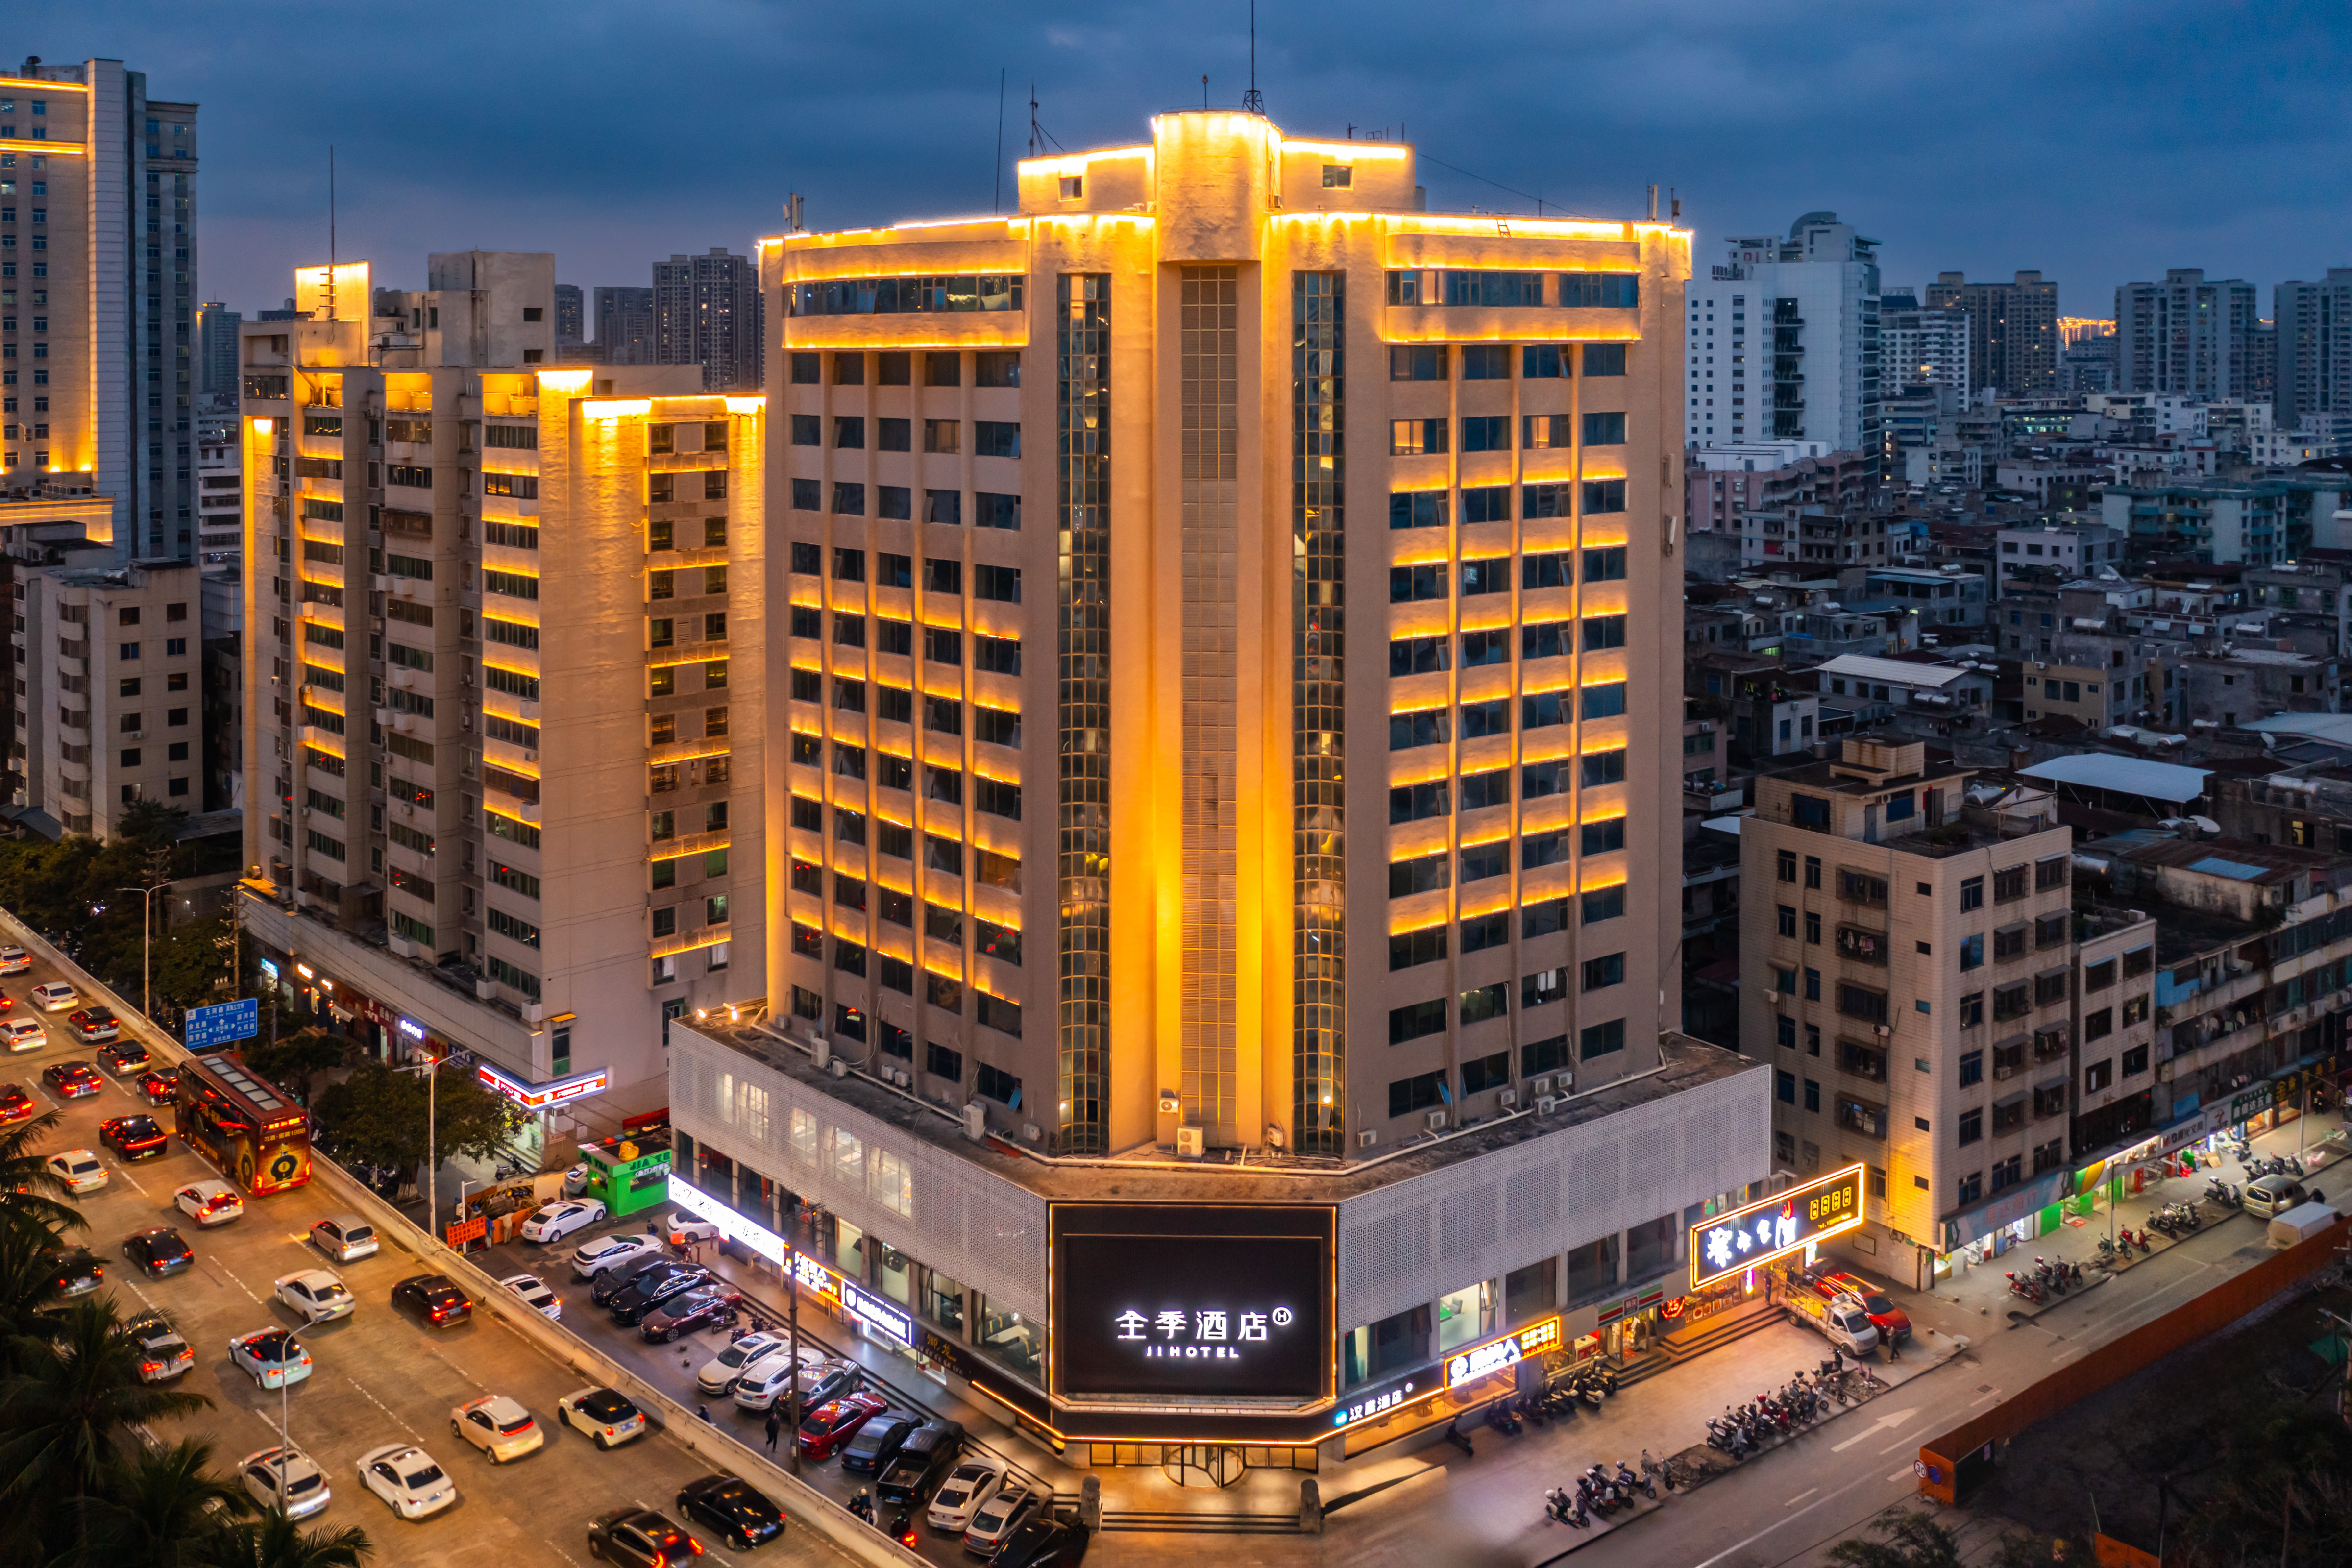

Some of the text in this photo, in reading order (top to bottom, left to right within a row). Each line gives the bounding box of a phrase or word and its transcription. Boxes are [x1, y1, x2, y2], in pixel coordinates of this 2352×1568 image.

[629, 1158, 650, 1170] JIA
[1115, 1310, 1268, 1340] 全季酒店
[1170, 1346, 1239, 1358] HOTEL
[1916, 1463, 1925, 1476] 30
